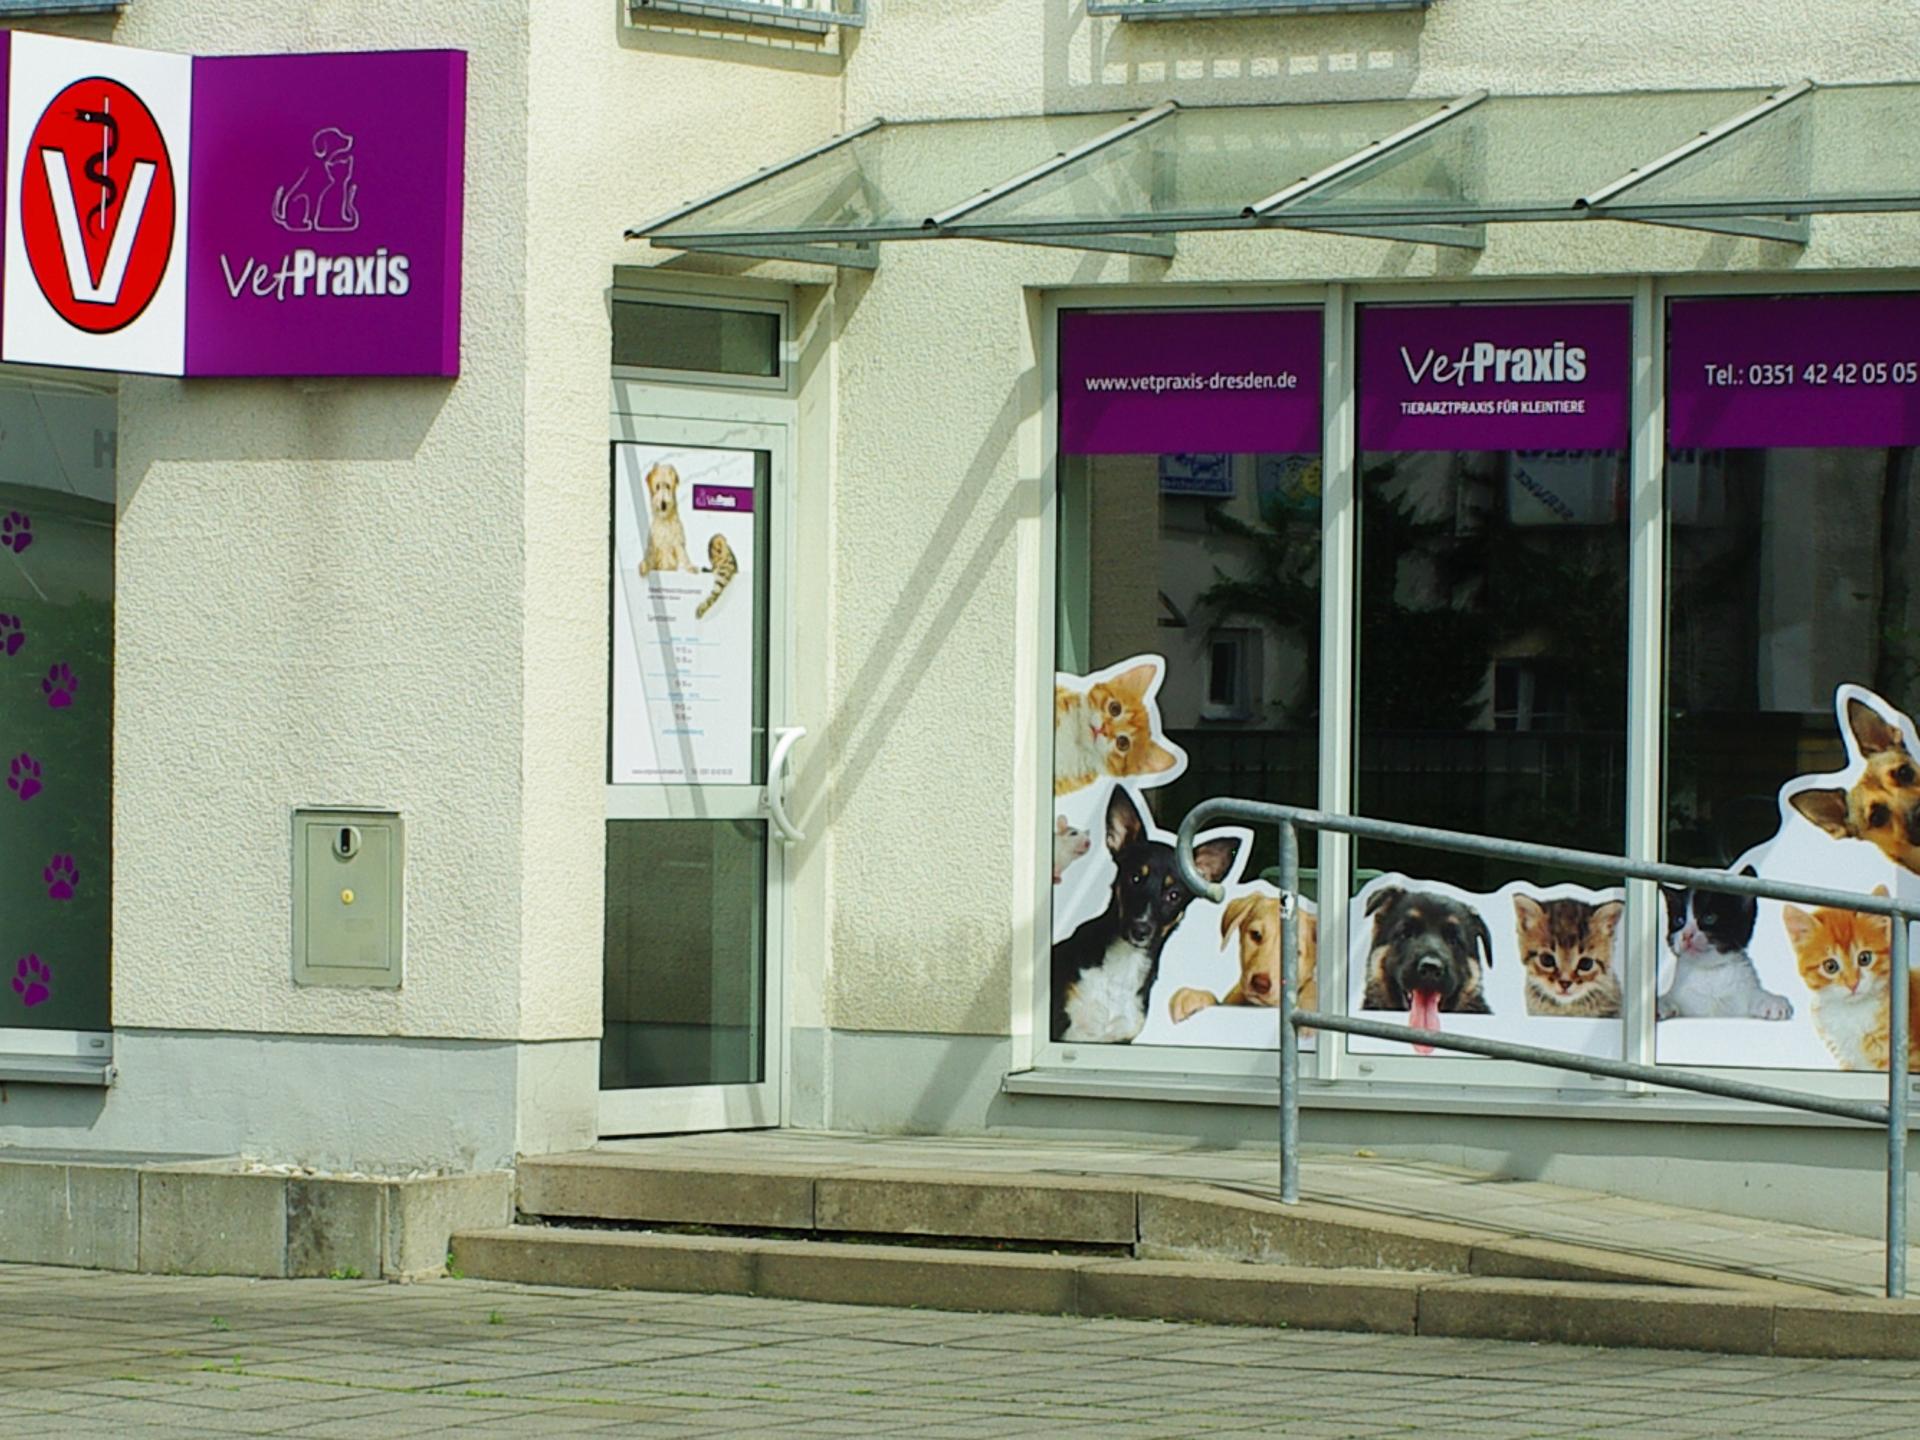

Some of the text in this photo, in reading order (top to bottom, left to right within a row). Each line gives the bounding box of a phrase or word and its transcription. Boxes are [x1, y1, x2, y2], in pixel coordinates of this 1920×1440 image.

[40, 146, 157, 305] V
[220, 248, 410, 301] VetPraxis
[1400, 341, 1587, 387] VetPraxis
[1704, 362, 1918, 386] Tel.: 0351 42 42 05 05
[1085, 371, 1298, 394] www.vetpraxis-dresden.de
[1401, 399, 1585, 415] TIERARZTPRAXIS FÜR KLEINTIERE
